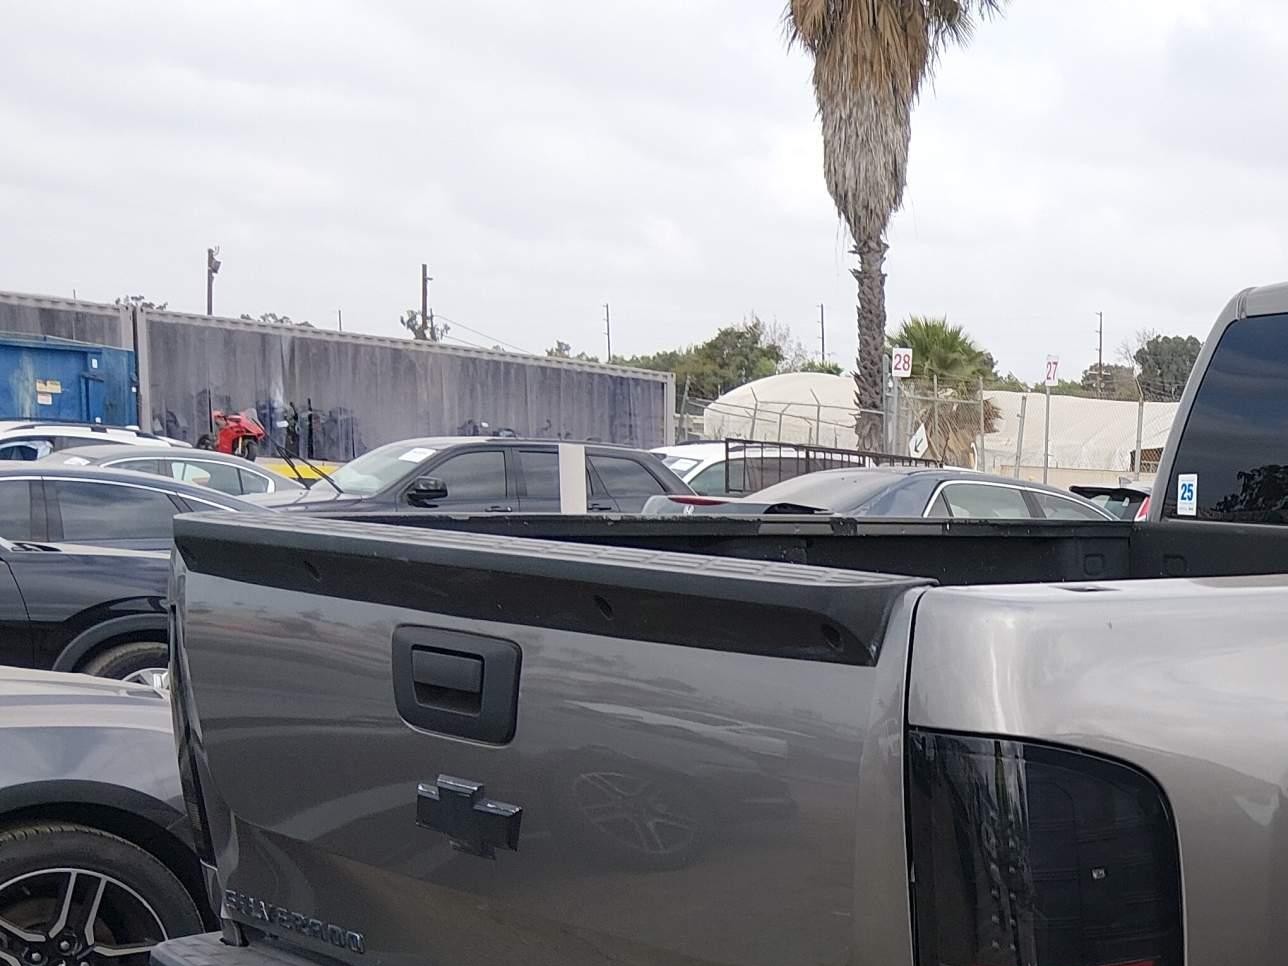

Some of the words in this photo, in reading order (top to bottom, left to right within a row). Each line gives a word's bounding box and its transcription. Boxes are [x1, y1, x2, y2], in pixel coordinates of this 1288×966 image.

[893, 353, 911, 371] 28
[1046, 361, 1058, 381] 27
[1180, 482, 1194, 501] 25
